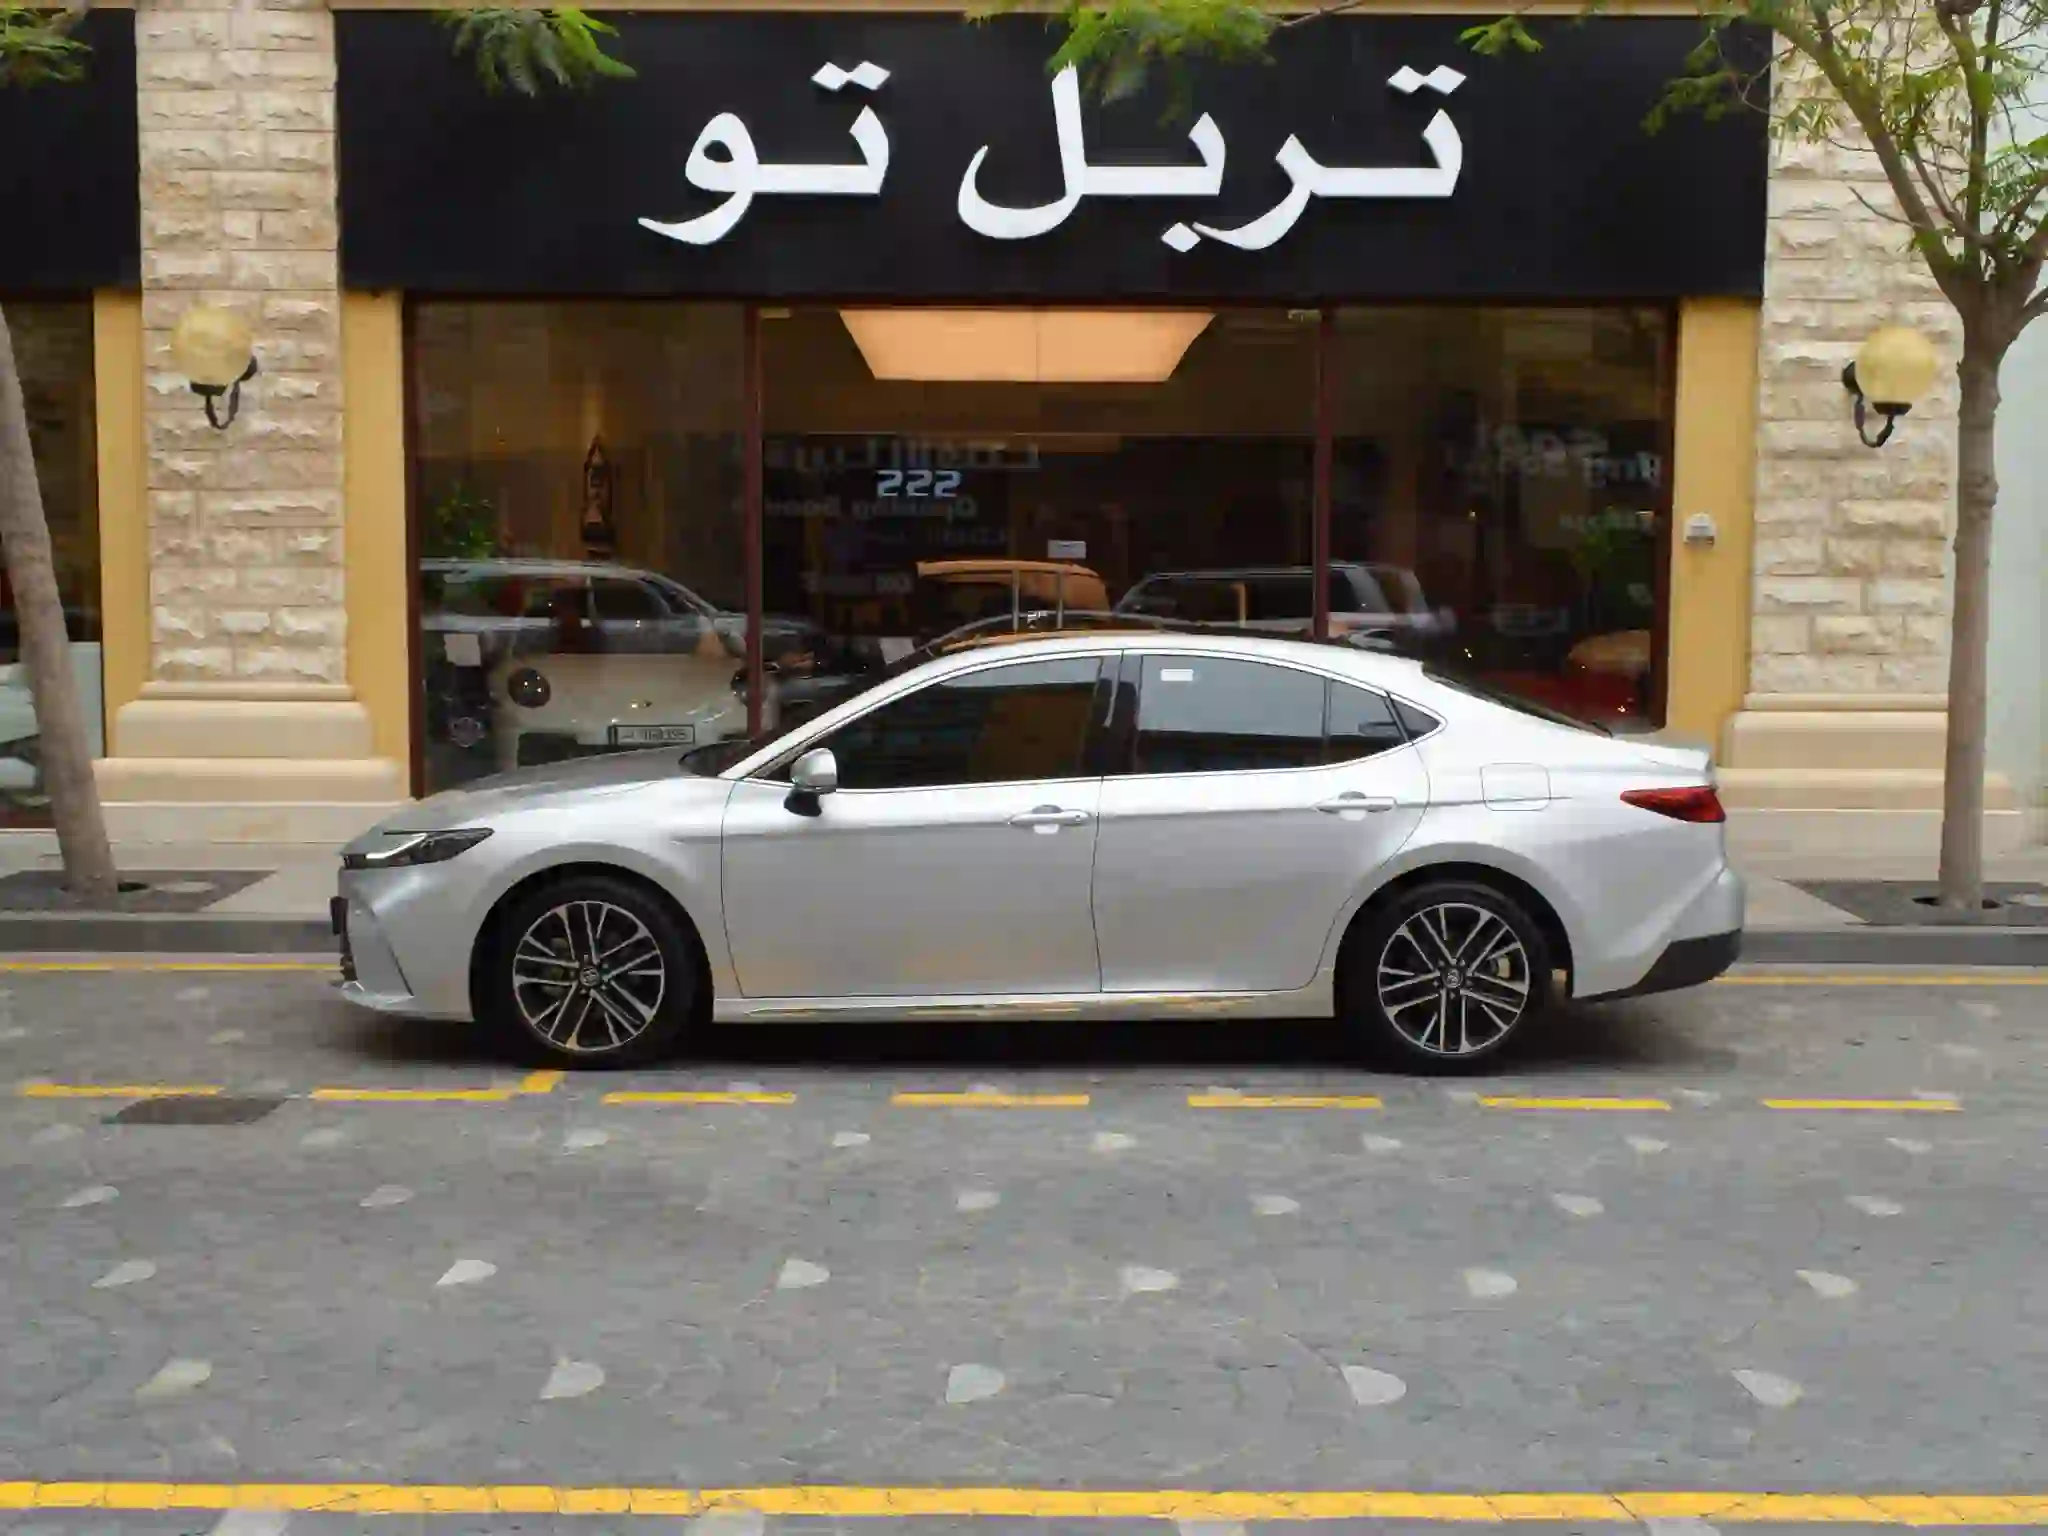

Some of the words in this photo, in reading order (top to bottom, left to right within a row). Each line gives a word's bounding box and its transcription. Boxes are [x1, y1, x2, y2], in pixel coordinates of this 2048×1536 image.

[637, 60, 891, 245] تو
[957, 61, 1467, 253] تربل
[875, 469, 962, 499] 222
